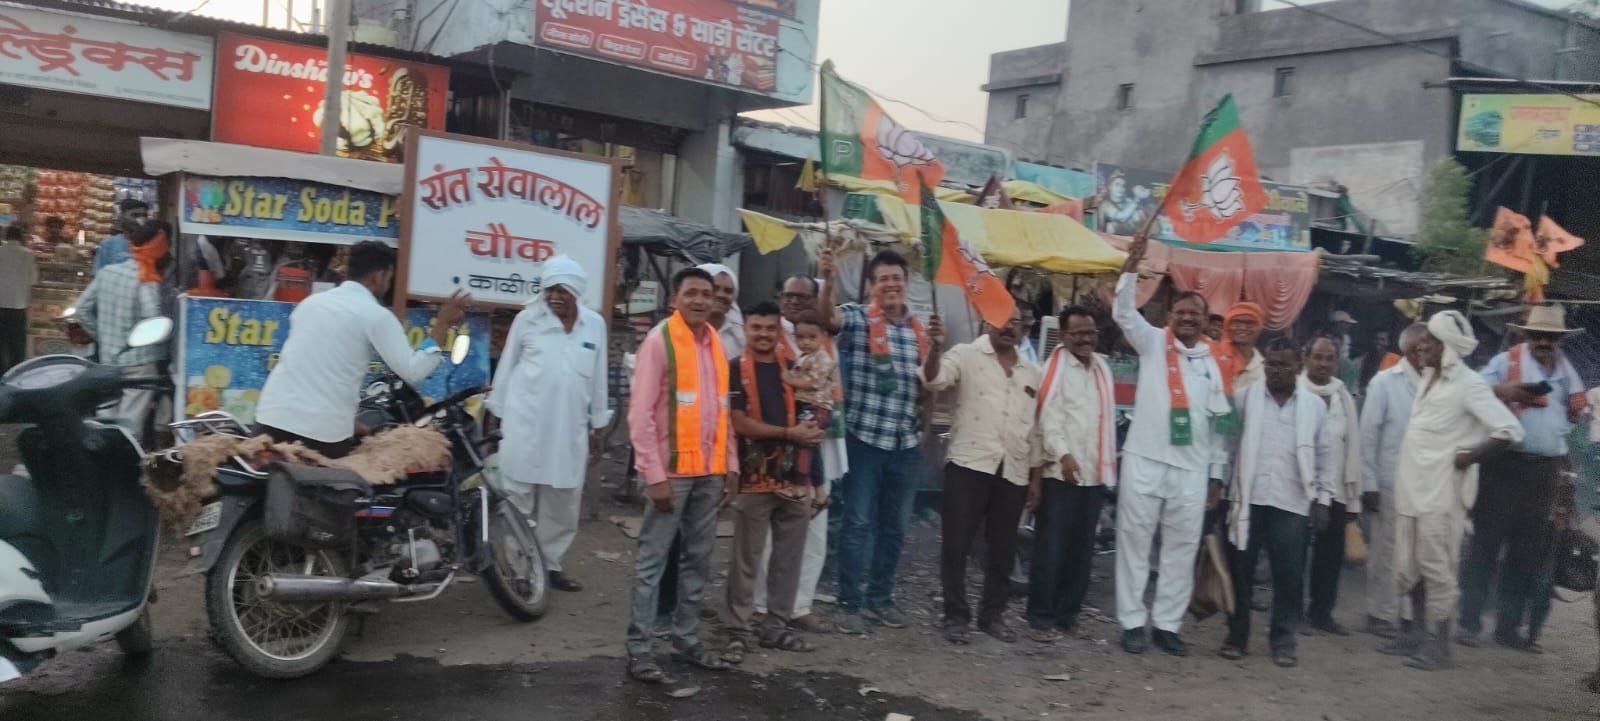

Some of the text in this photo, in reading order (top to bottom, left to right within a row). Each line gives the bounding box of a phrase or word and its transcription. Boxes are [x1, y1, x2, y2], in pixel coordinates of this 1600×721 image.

[223, 180, 288, 219] Star
[297, 186, 366, 226] Soda
[419, 157, 604, 229] संत सेवालाल
[465, 223, 555, 262] चौक
[205, 307, 279, 346] Star
